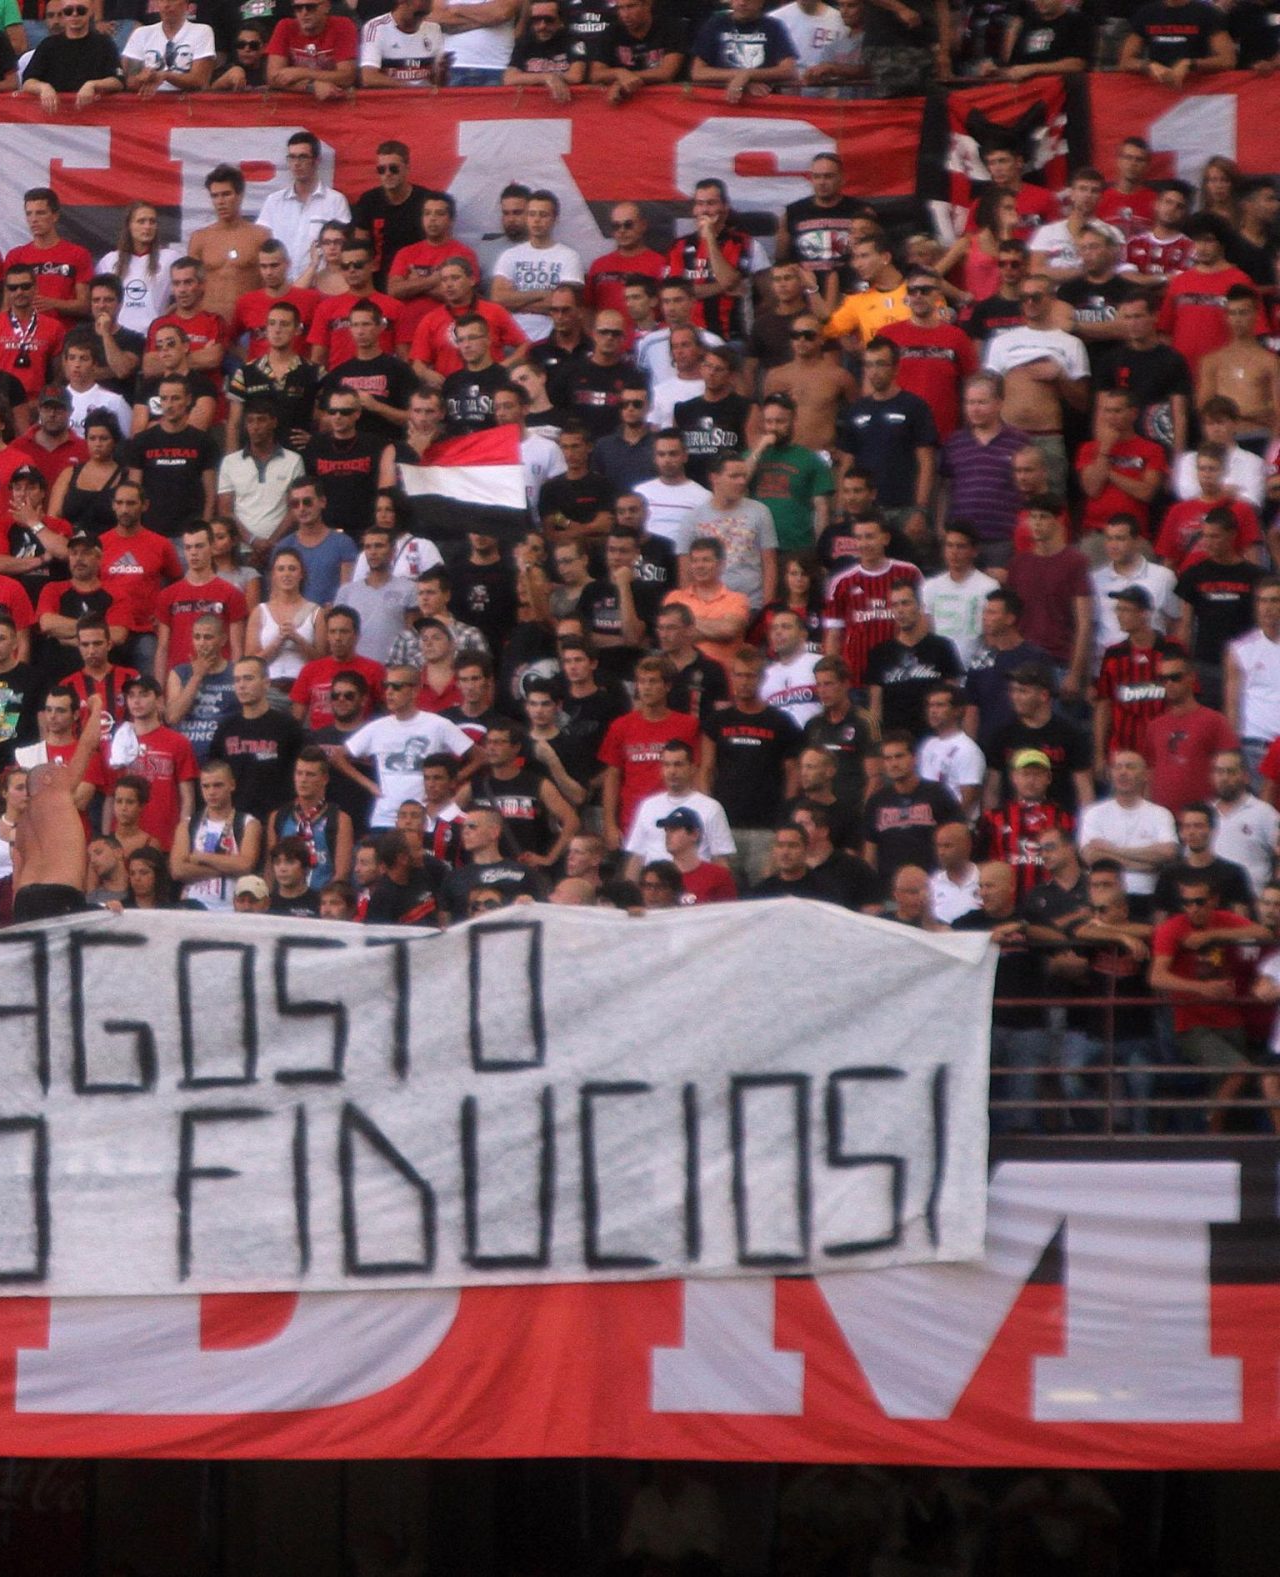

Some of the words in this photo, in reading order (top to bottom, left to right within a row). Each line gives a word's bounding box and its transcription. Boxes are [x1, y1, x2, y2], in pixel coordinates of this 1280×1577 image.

[146, 448, 198, 459] ULTRAS
[108, 565, 144, 575] adidas
[1122, 686, 1166, 702] bwin
[176, 1063, 949, 1283] FIDUCIOSI
